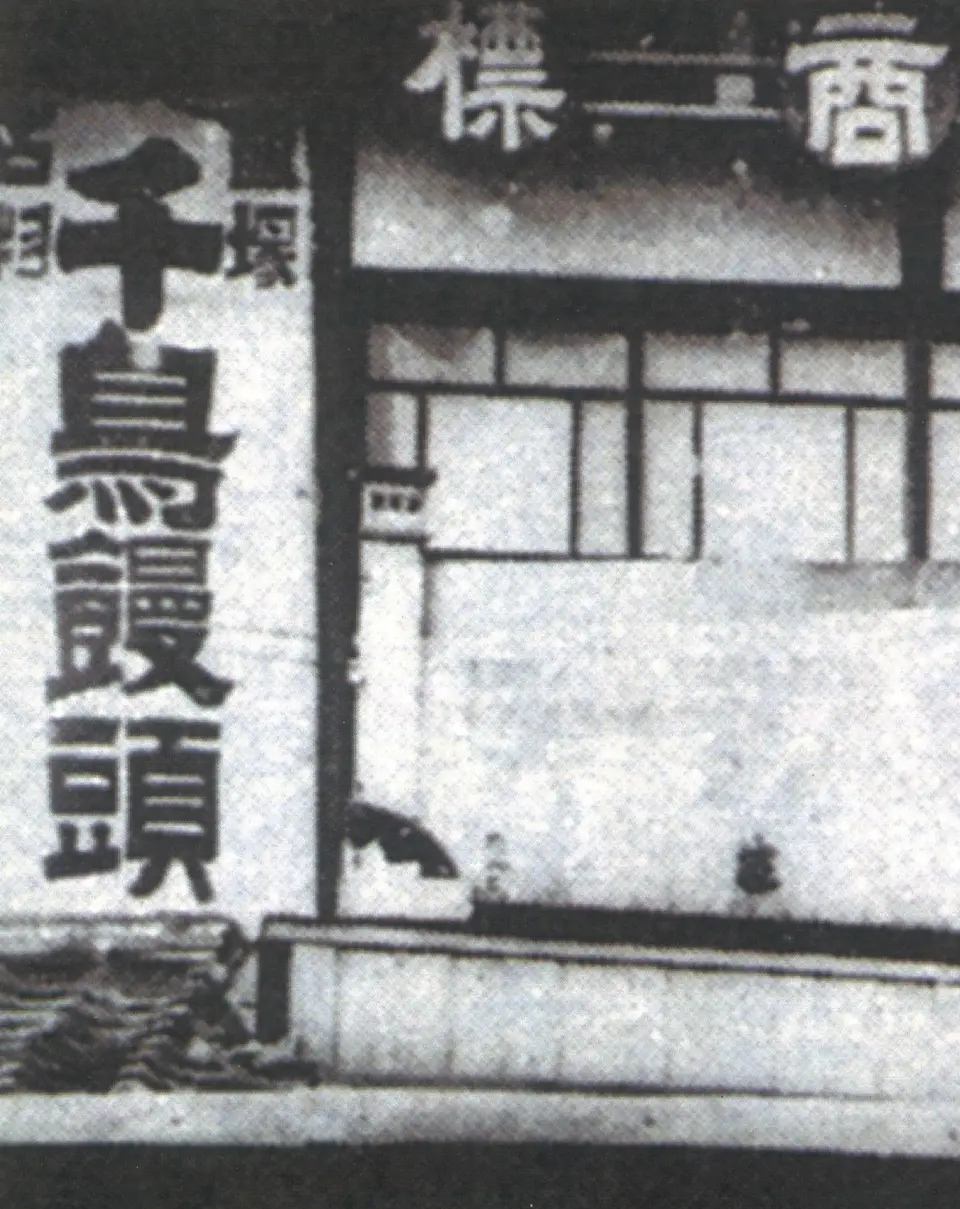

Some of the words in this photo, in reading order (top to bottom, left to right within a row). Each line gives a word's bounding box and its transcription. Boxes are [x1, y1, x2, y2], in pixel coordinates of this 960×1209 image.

[785, 13, 950, 166] 商
[44, 136, 239, 902] 千鳥饅頭
